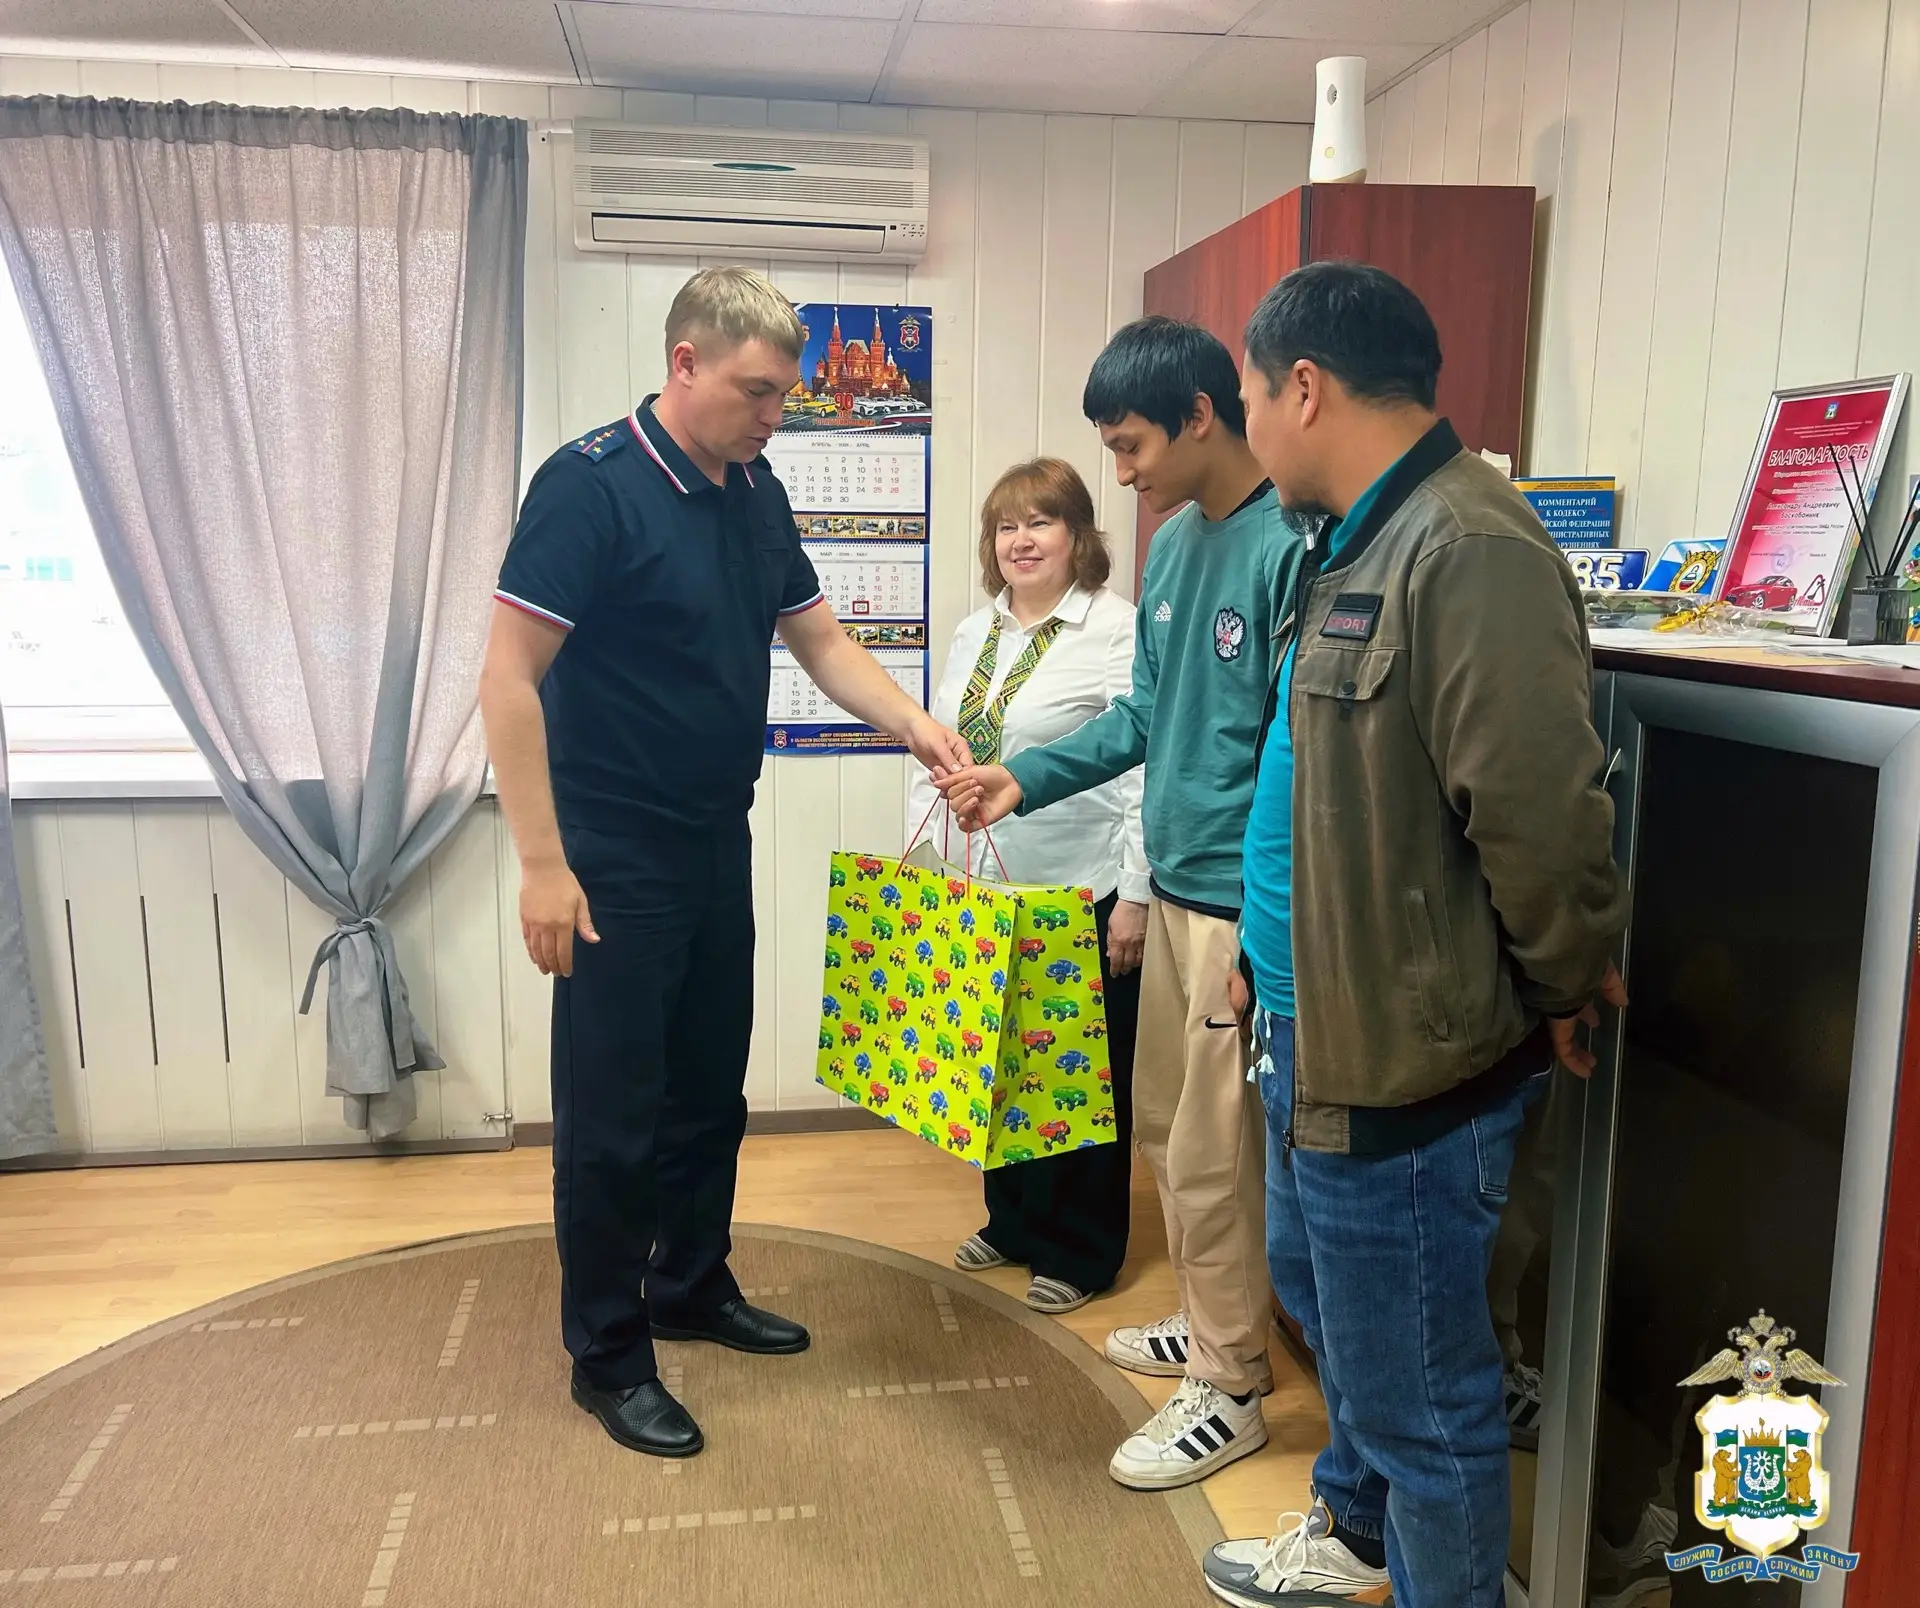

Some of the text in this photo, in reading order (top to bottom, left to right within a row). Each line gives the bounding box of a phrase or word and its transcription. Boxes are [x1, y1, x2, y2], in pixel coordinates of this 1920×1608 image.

[834, 392, 854, 411] 90
[1767, 443, 1869, 467] БЛАГОДАРНОСТЬ
[788, 485, 798, 493] 20
[805, 485, 814, 493] 21
[822, 485, 832, 493] 22
[839, 485, 849, 493] 23
[1537, 496, 1597, 507] КОММЕНТАРИЙ
[1546, 509, 1588, 518] К КОДЕКСУ
[1541, 519, 1611, 528] ЙСКОЙ ФЕДЕРАЦИИ
[1549, 530, 1610, 539] ИНИСТРАТИВНЫХ
[1571, 556, 1625, 590] 85
